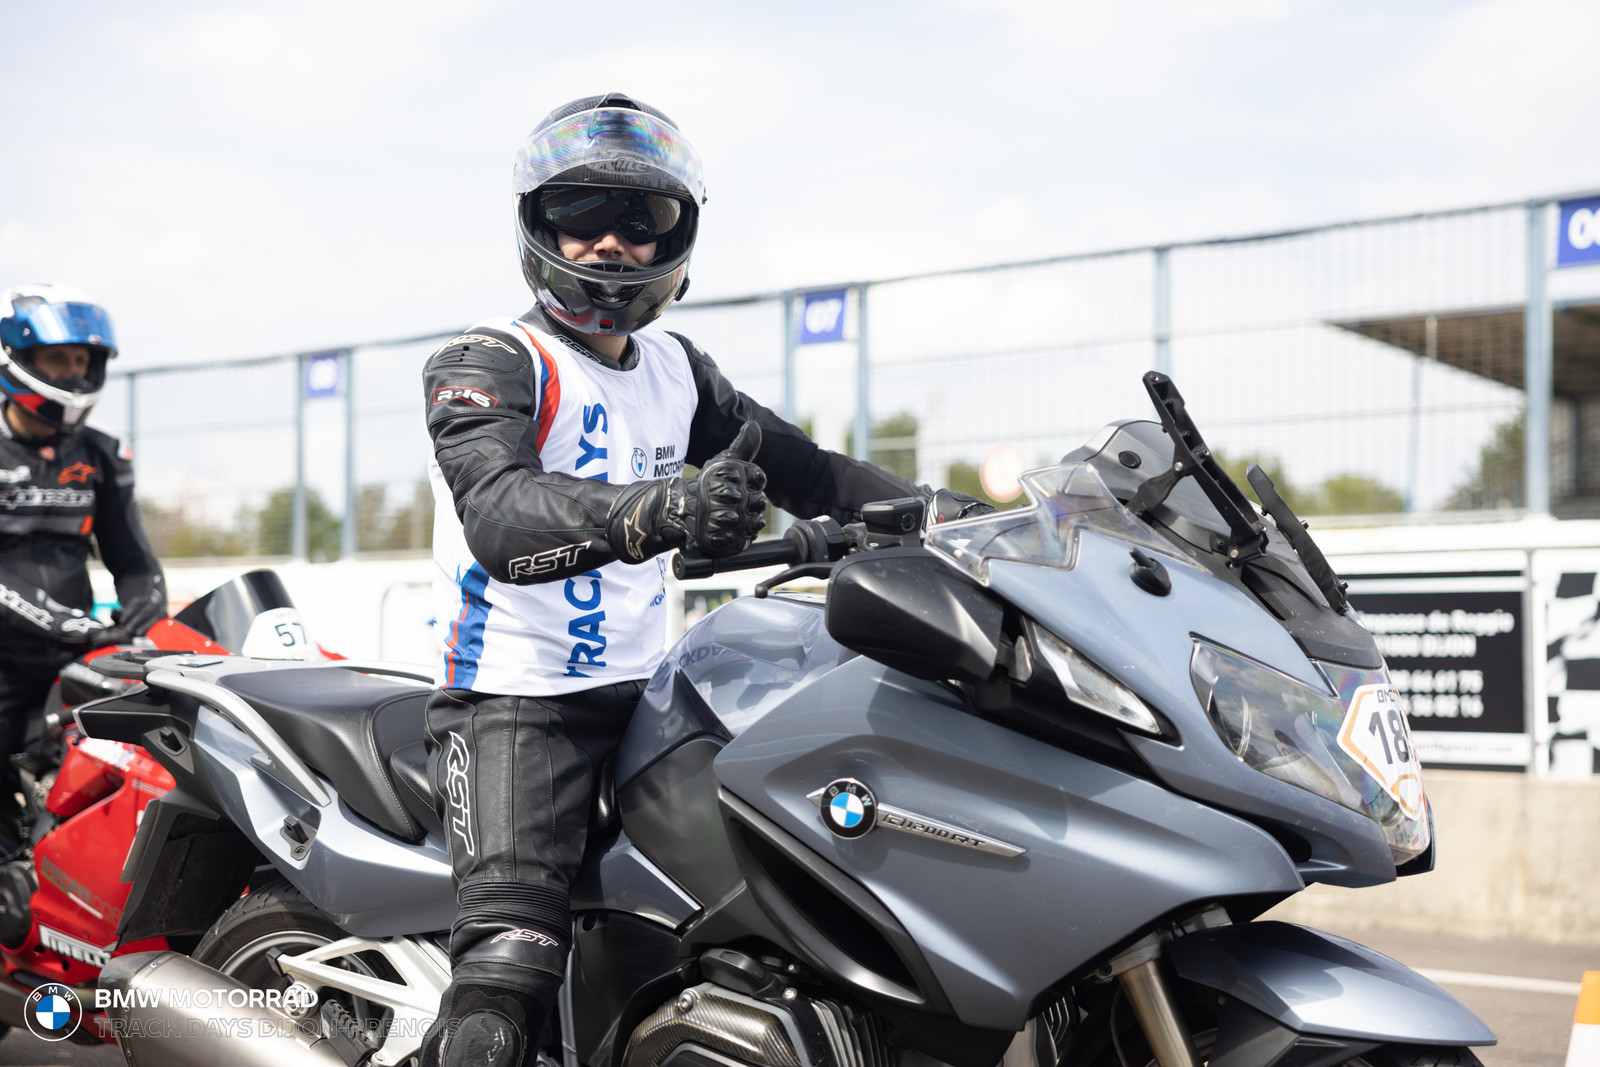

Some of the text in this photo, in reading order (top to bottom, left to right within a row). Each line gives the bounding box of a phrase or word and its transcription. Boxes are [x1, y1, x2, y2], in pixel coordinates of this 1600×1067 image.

[655, 444, 676, 461] BMW
[508, 540, 592, 580] RST
[274, 621, 308, 647] 57
[445, 729, 475, 857] RST
[829, 783, 873, 807] BMW
[41, 855, 92, 904] DUCATI
[490, 928, 558, 947] RST
